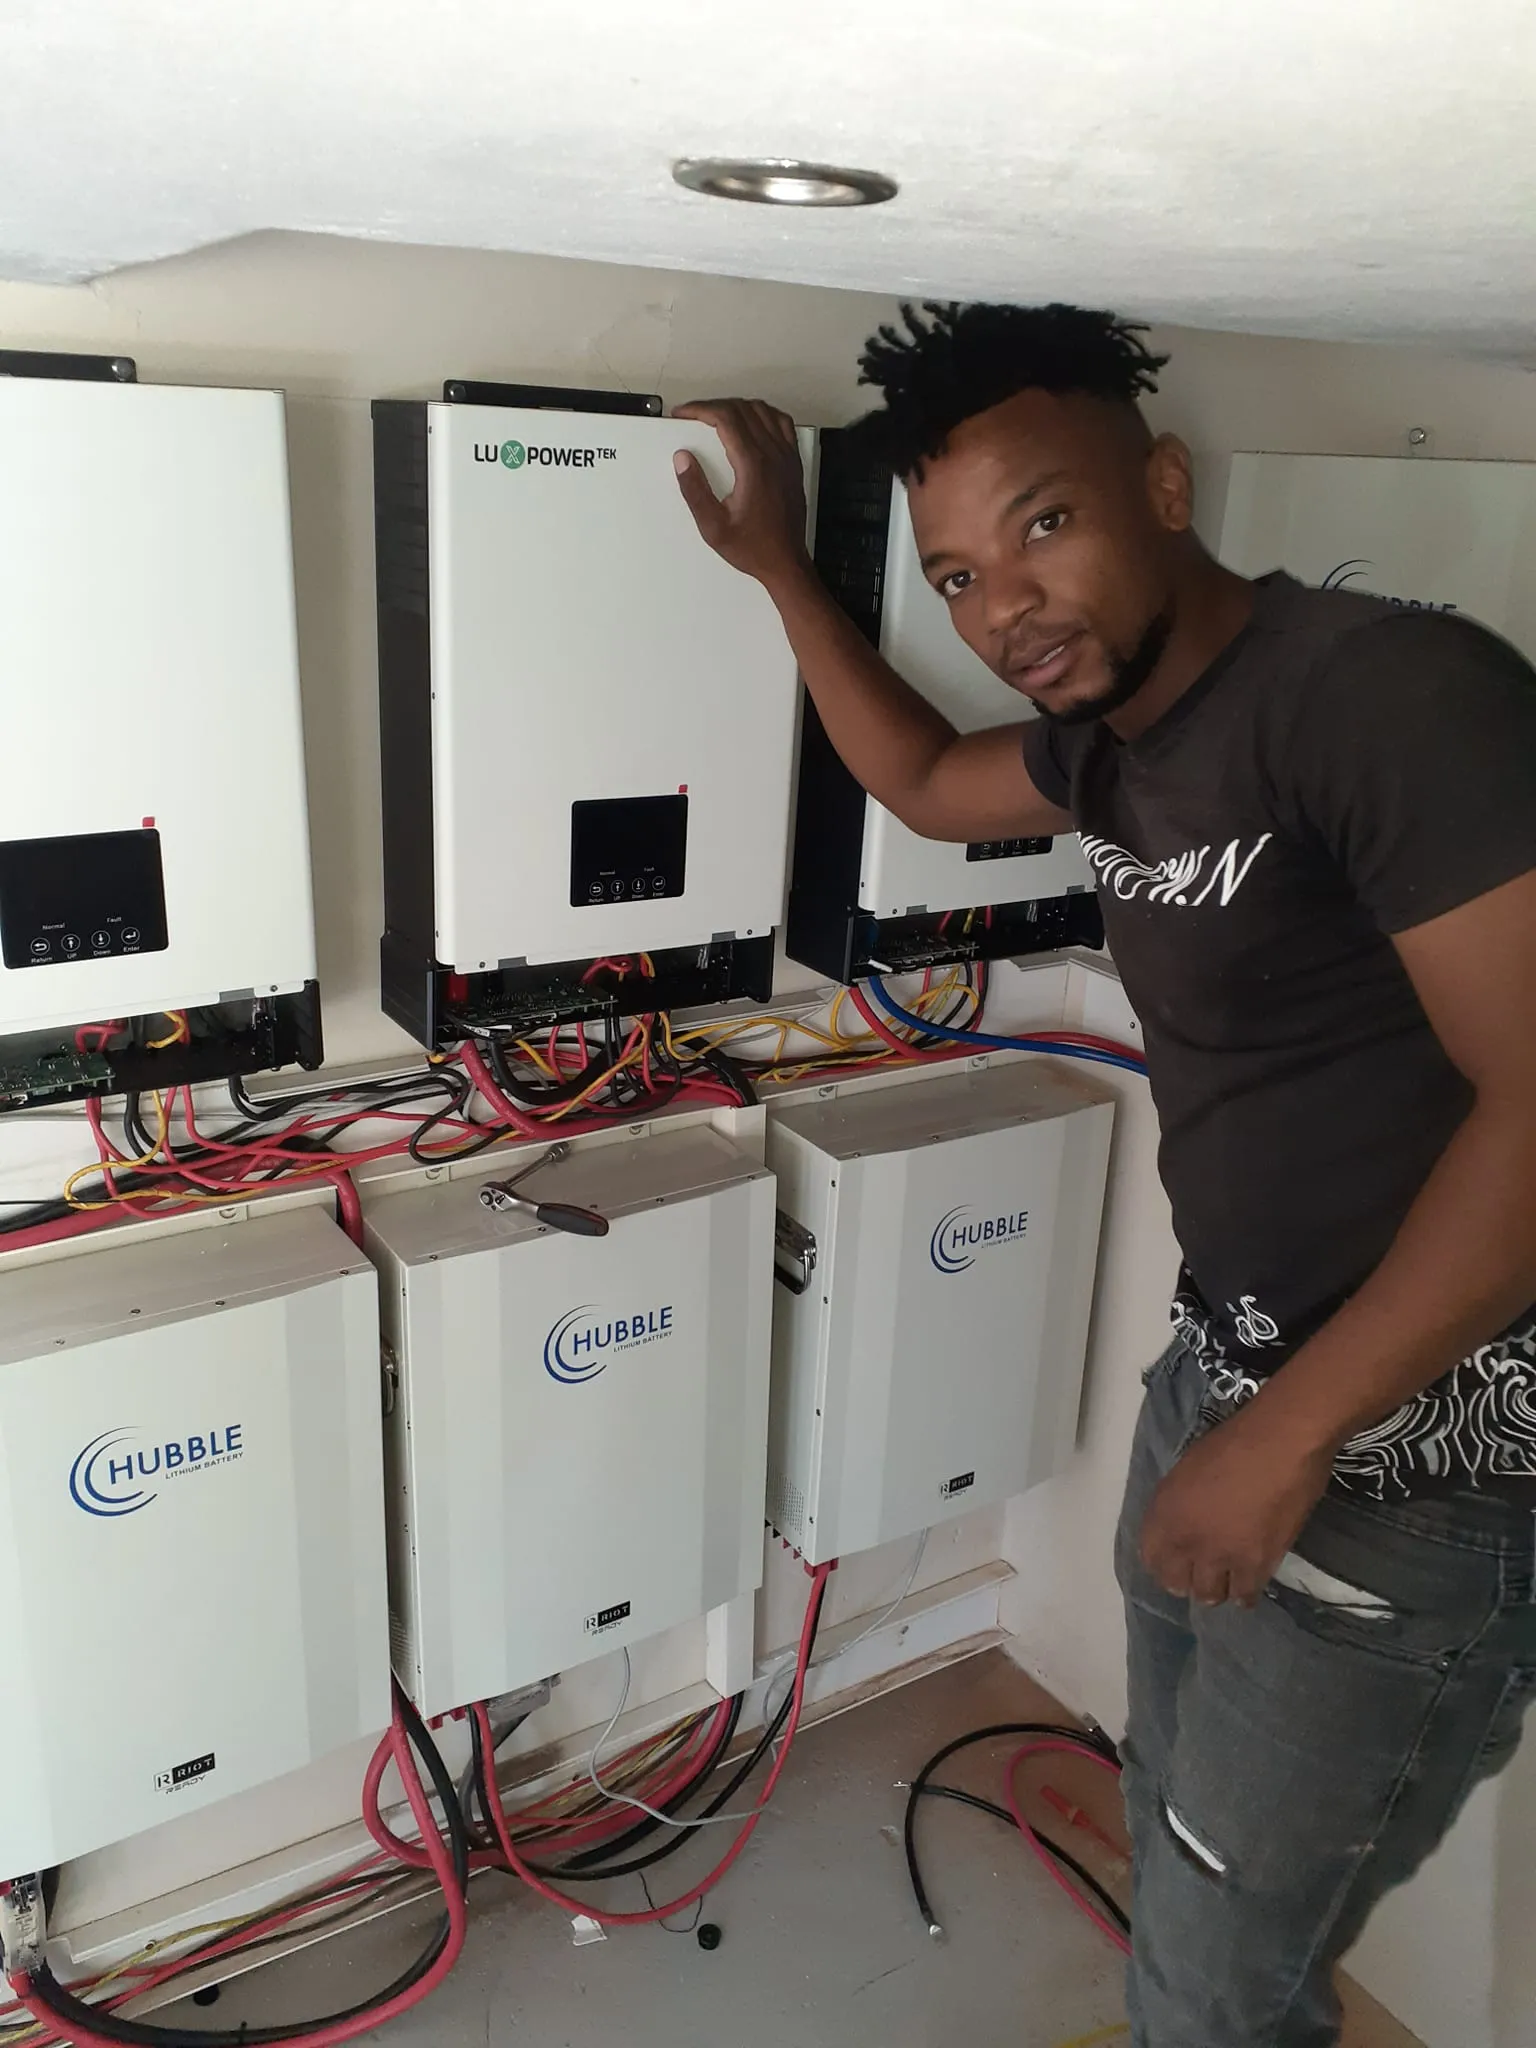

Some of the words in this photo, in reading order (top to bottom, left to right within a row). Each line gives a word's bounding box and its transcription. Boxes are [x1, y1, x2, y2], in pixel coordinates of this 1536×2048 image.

[42, 922, 66, 931] Normal
[30, 956, 53, 964] Return
[123, 945, 140, 953] Enter
[952, 1211, 1029, 1249] HUBBLE
[573, 1305, 673, 1356] HUBBLE
[613, 1341, 641, 1353] LITHIUM
[643, 1331, 673, 1344] BATTERY
[108, 1423, 243, 1485] HUBBLE
[165, 1464, 202, 1480] LITHIUM
[203, 1451, 244, 1468] BATTERY
[601, 1604, 629, 1622] RIOT
[177, 1757, 213, 1778] RIOT
[165, 1775, 207, 1795] READY
